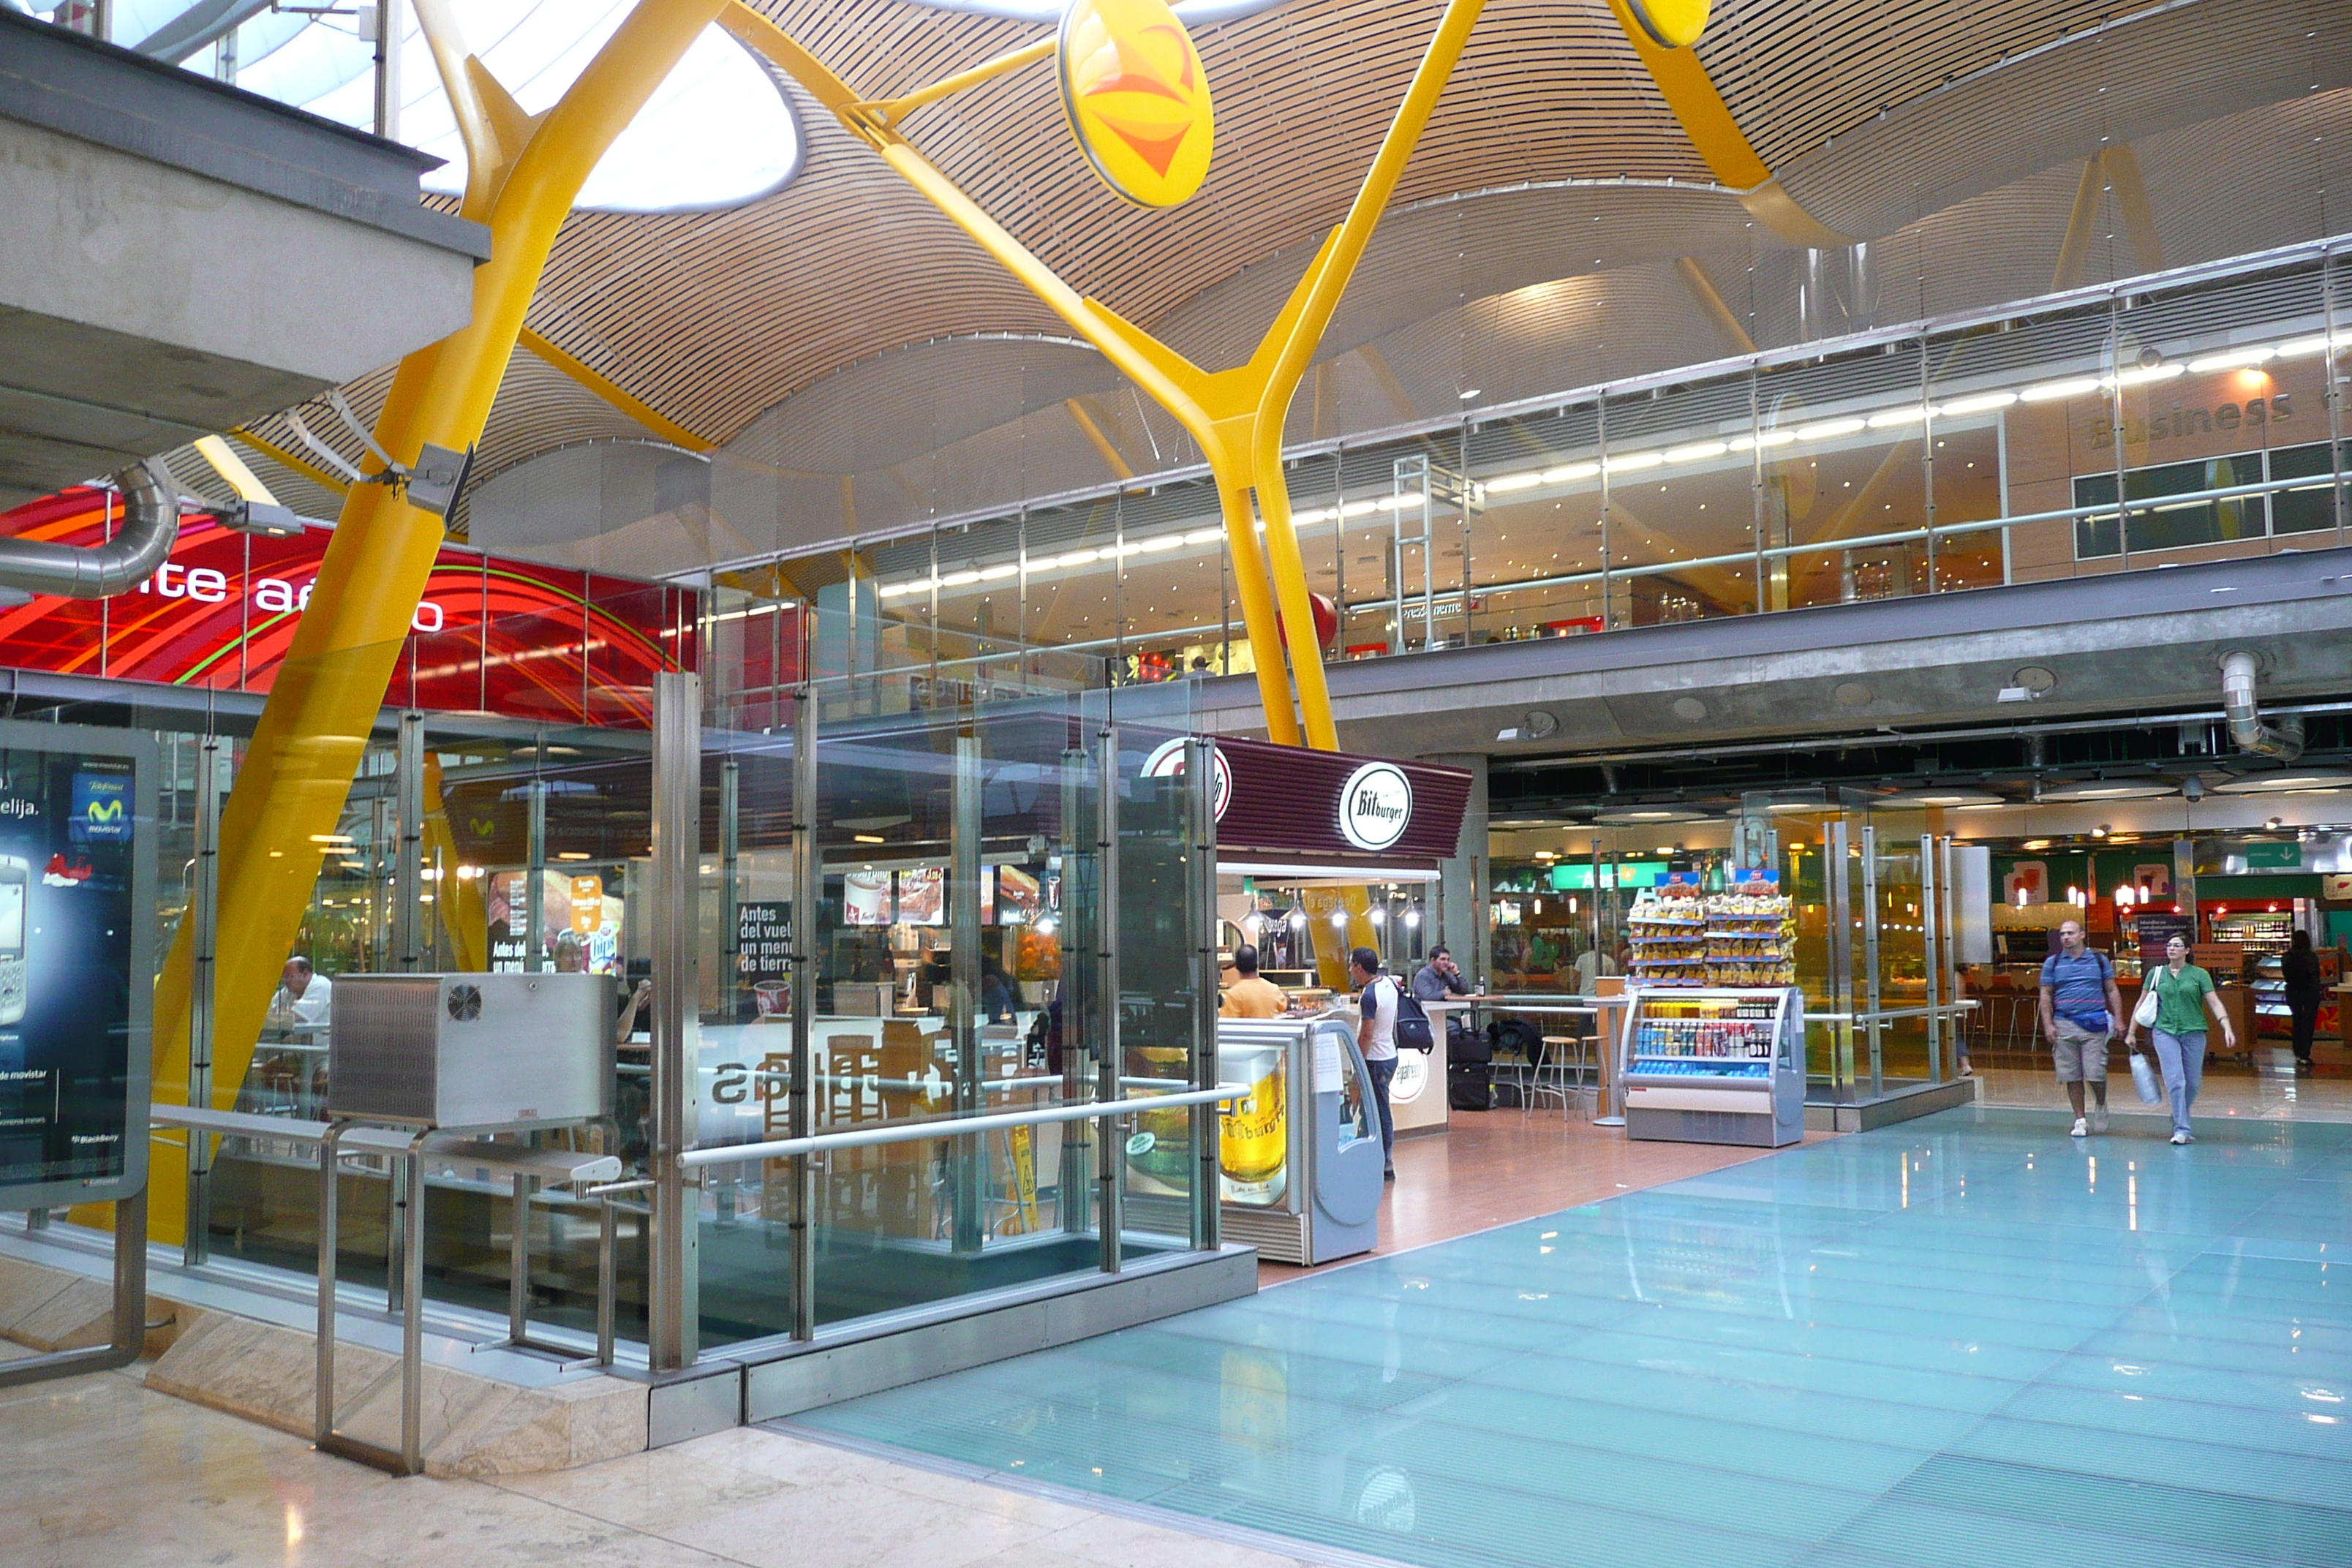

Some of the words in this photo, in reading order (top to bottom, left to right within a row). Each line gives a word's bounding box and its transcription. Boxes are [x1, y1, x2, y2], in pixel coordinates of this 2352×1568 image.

[2089, 393, 2291, 449] Business
[140, 560, 226, 603] te
[1, 798, 39, 819] elija.
[1356, 789, 1403, 823] Bitburger
[740, 905, 776, 921] Antes
[740, 921, 761, 938] del
[764, 921, 791, 938] vuel
[493, 941, 513, 957] Antes
[515, 941, 527, 957] del
[741, 942, 756, 954] un
[493, 962, 503, 973] un
[504, 957, 524, 973] menú
[741, 955, 756, 971] de
[10, 1069, 48, 1079] movistar
